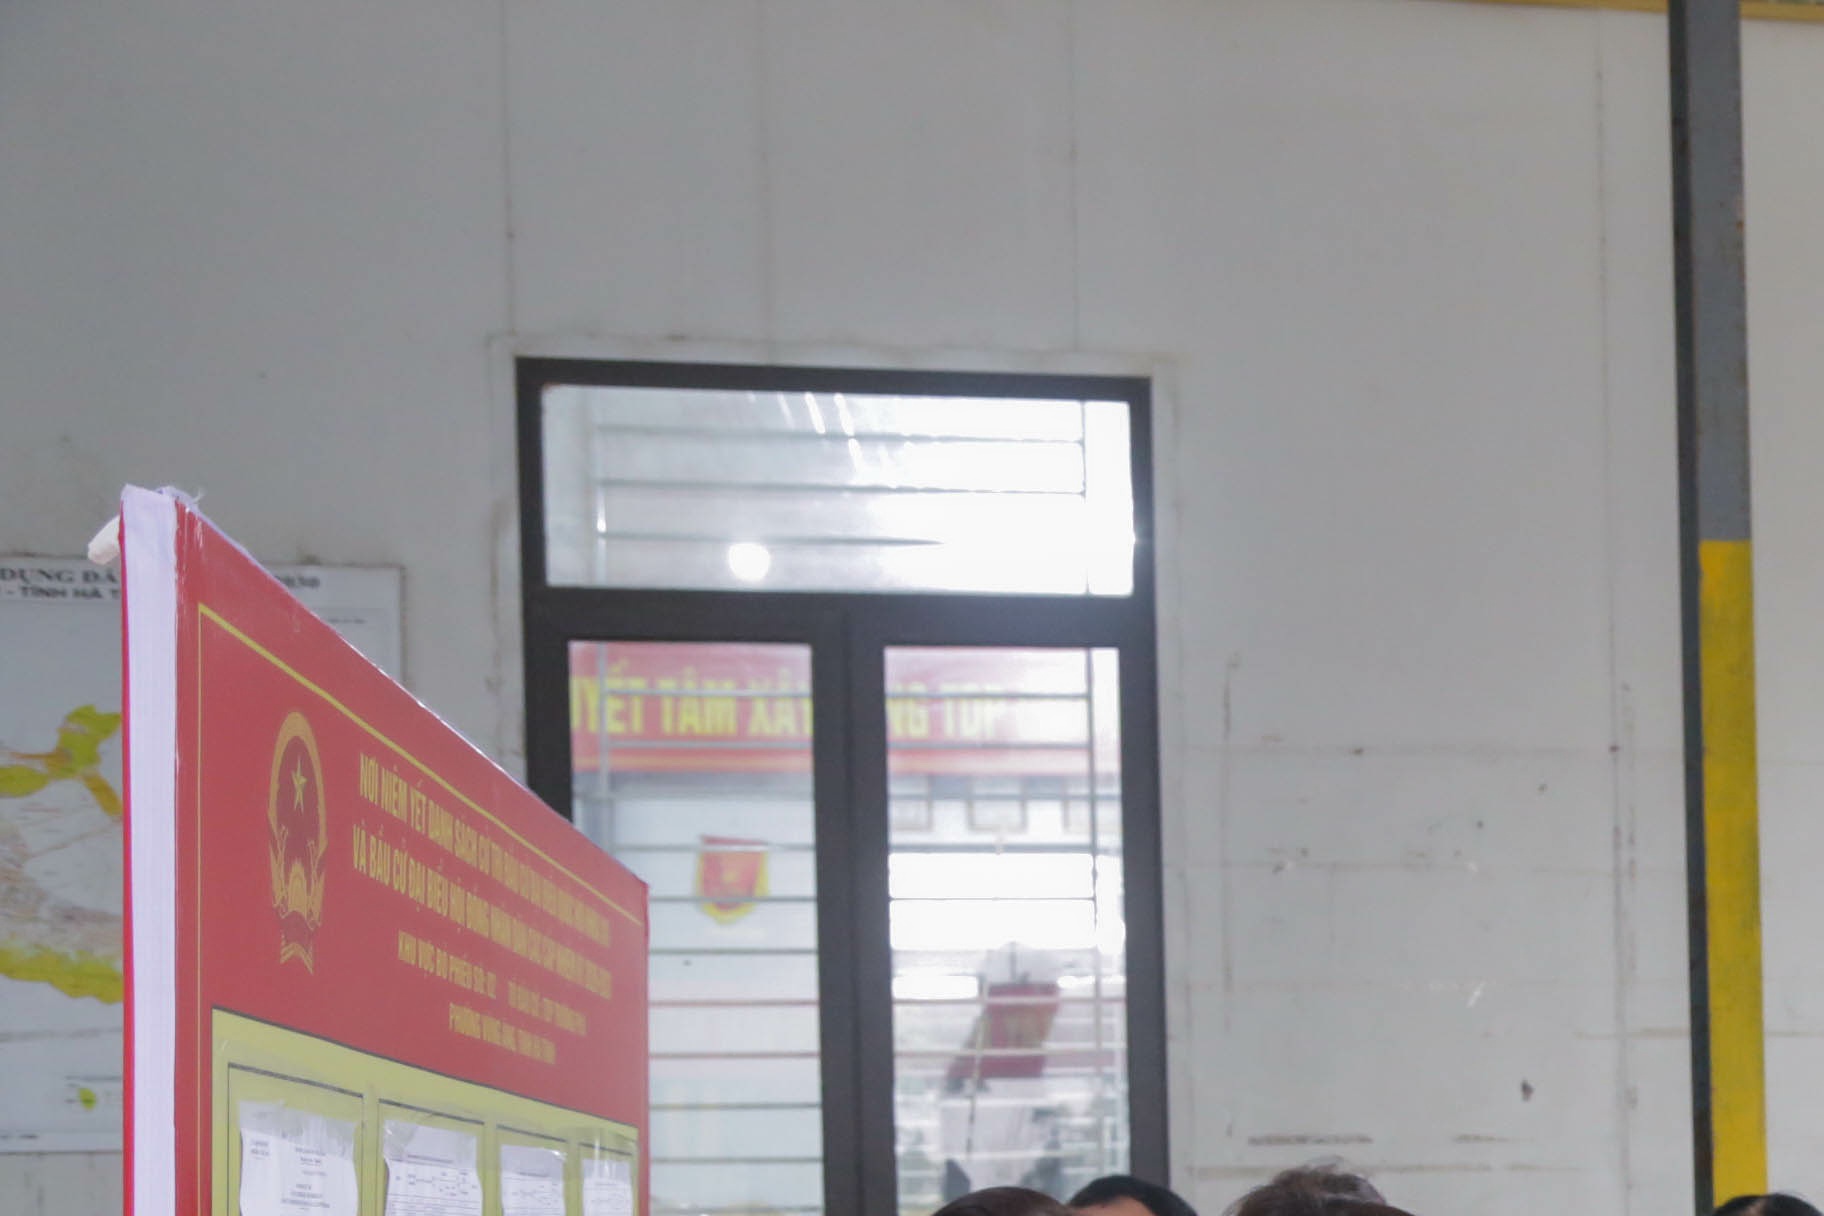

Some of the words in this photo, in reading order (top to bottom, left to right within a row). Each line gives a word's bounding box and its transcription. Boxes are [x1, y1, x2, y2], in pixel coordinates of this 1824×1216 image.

[657, 666, 737, 736] TÂM
[360, 753, 379, 806] NƠI
[381, 765, 408, 823] NIÊM
[410, 779, 427, 834] YẾT
[353, 819, 367, 874] VÀ
[369, 824, 391, 886] BẦU
[393, 837, 408, 895] CỬ
[408, 857, 425, 913] ĐẠI
[427, 857, 449, 917] BIỂU
